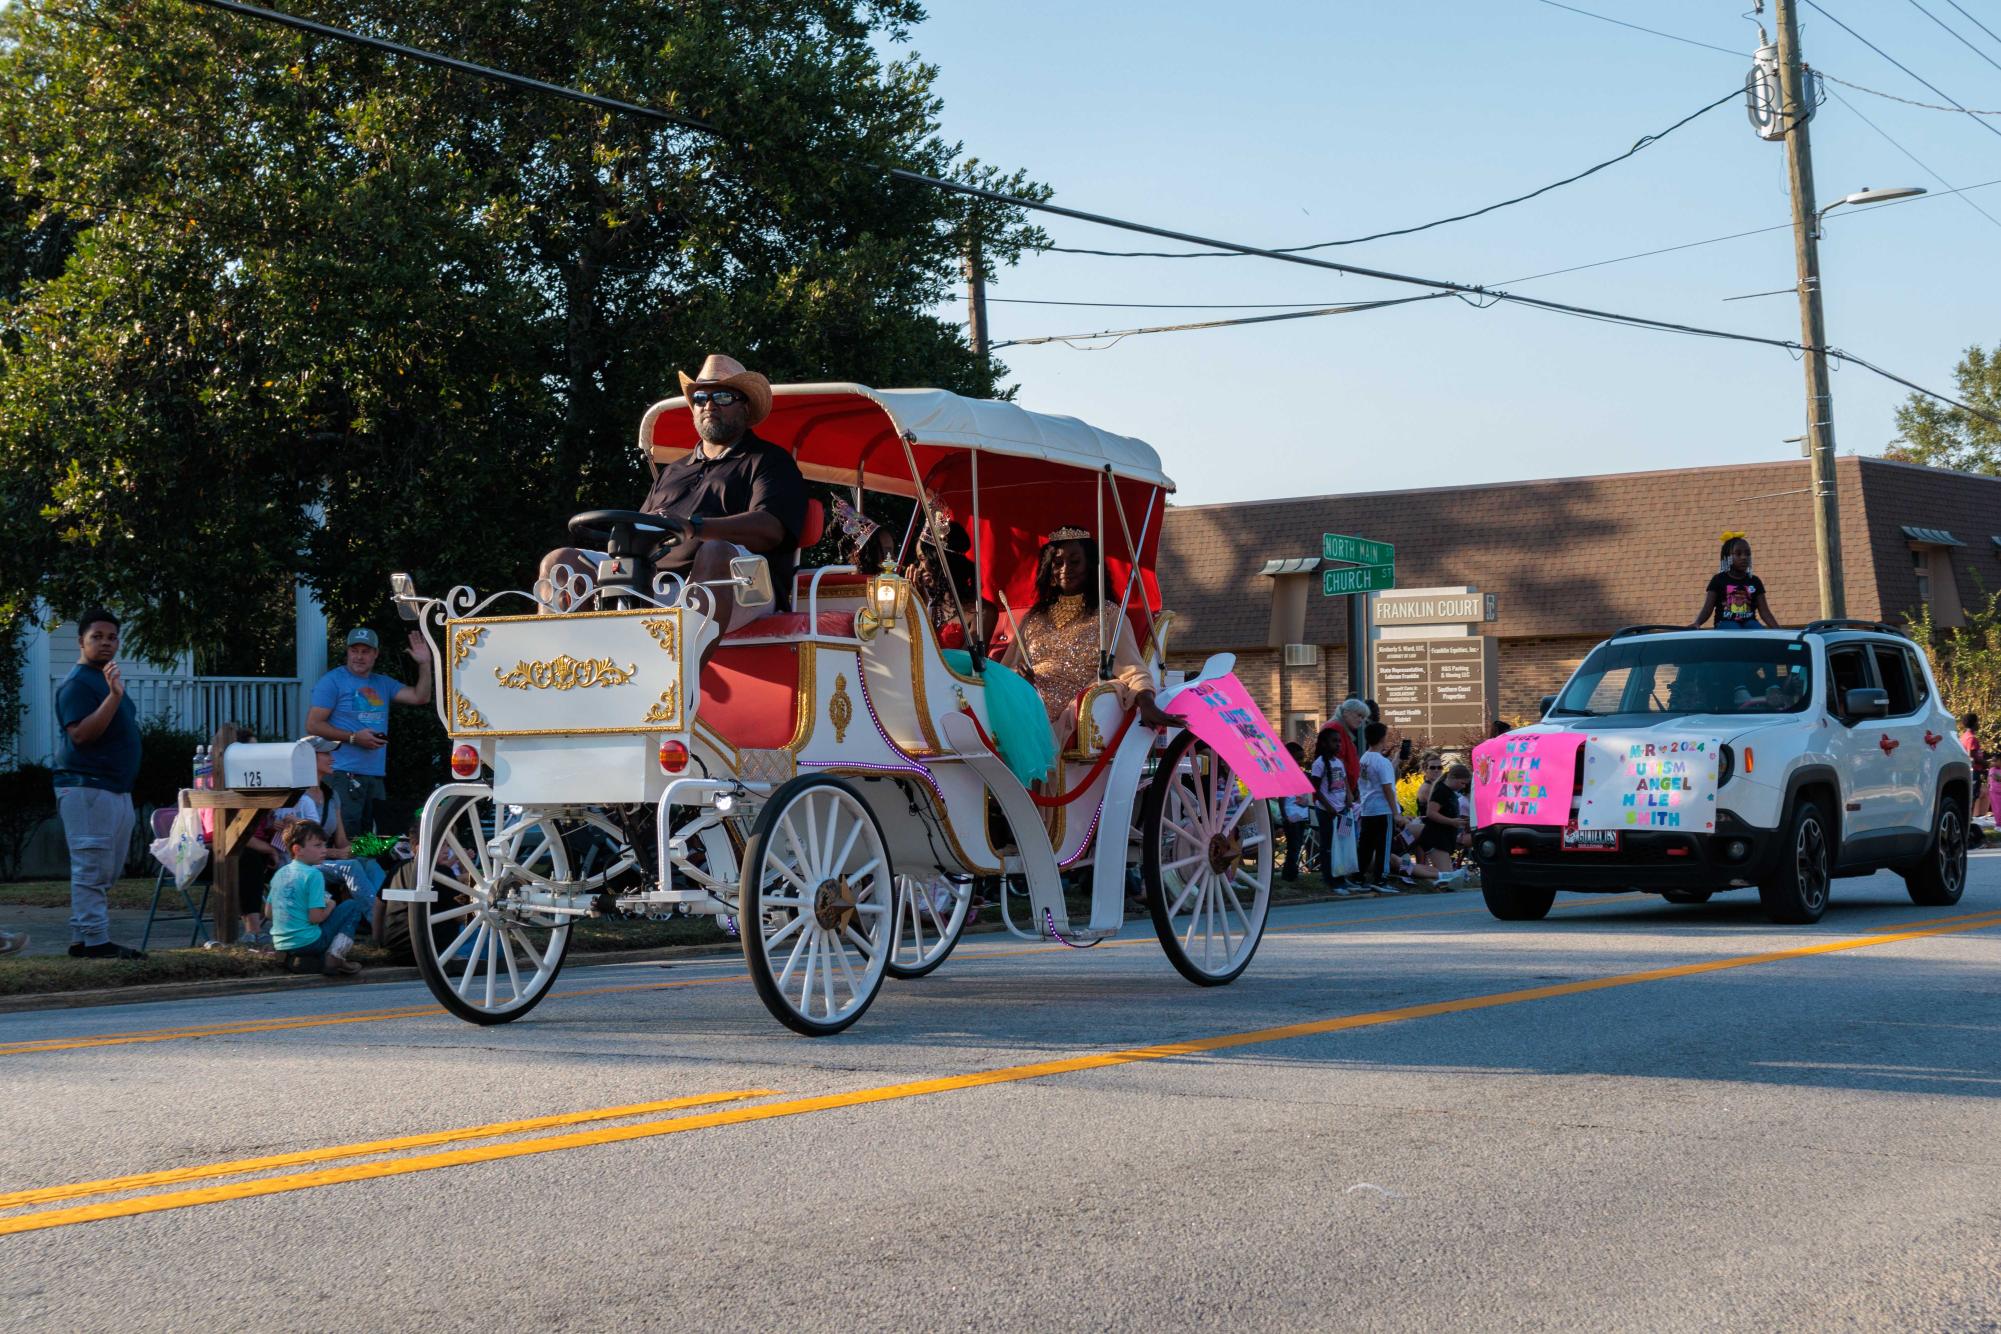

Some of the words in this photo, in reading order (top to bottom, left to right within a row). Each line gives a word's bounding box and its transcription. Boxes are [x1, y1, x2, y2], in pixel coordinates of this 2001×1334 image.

[1326, 538, 1355, 560] NORTH
[1360, 543, 1378, 564] MAIN
[1326, 570, 1372, 592] CHURCH
[1382, 567, 1392, 578] ST
[1376, 601, 1434, 619] FRANKLIN
[1438, 599, 1480, 617] COURT
[1670, 740, 1705, 754] 2024
[1625, 760, 1687, 777] AUTISM
[244, 771, 262, 786] 125
[1636, 776, 1692, 791] ANGEL
[1498, 783, 1548, 799] ALYSSA
[1622, 792, 1681, 807] MYLES
[1496, 800, 1538, 816] SMITH
[1625, 811, 1680, 827] SMITH
